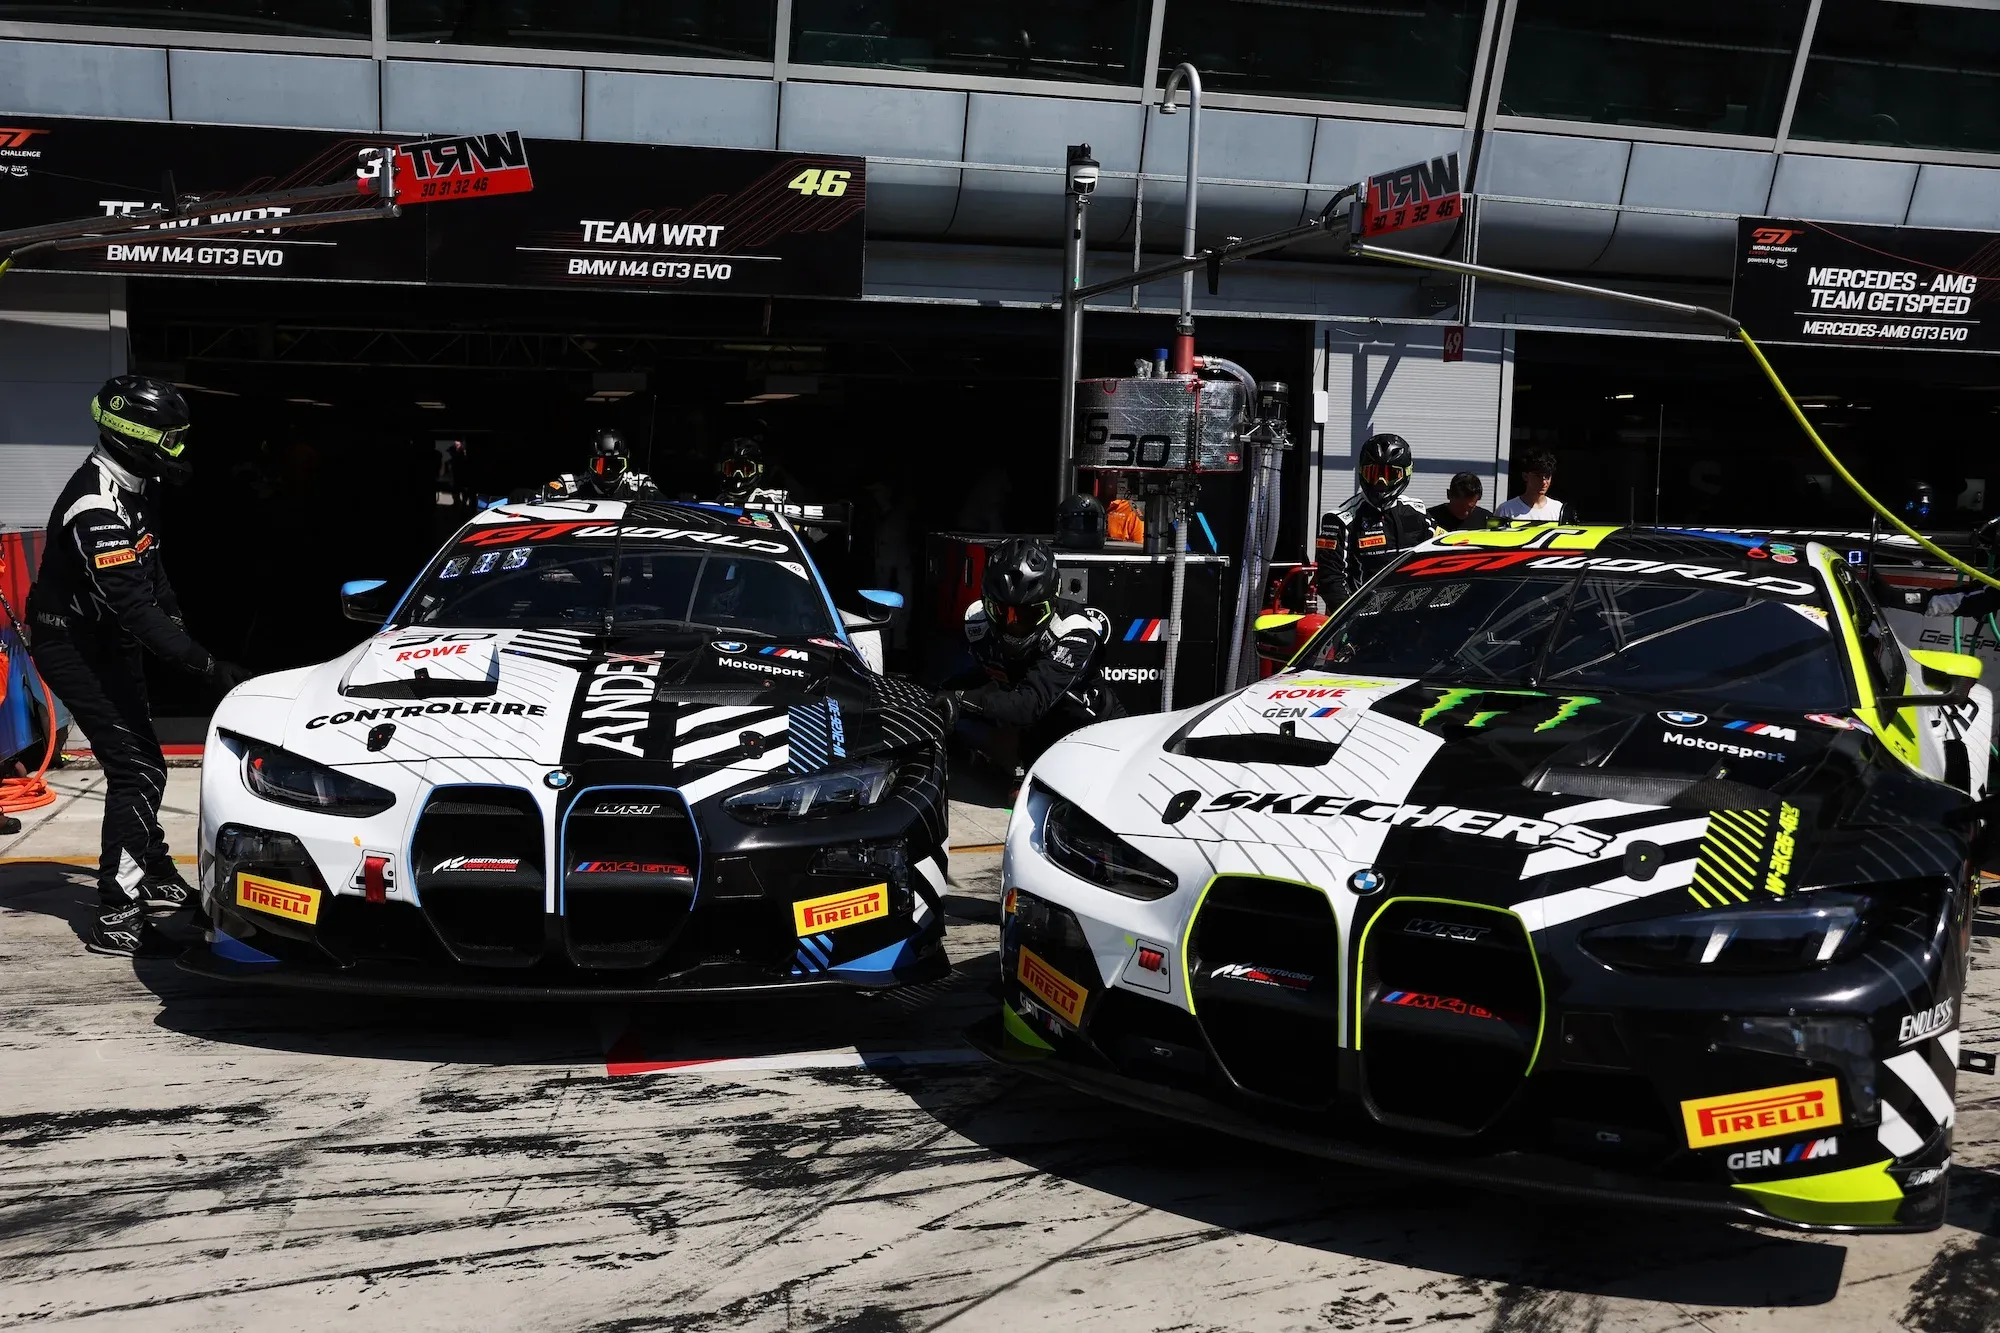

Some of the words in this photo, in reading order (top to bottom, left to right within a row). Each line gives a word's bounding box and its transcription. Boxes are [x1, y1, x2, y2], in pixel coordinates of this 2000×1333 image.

[0, 128, 51, 148] T
[0, 149, 41, 158] CHALLENGE
[421, 183, 436, 198] 30
[438, 181, 453, 196] 31
[453, 179, 470, 194] 32
[472, 177, 489, 191] 46
[787, 168, 852, 197] 46
[1393, 209, 1407, 227] 31
[1412, 204, 1430, 223] 32
[1435, 199, 1456, 217] 46
[579, 219, 657, 245] TEAM
[662, 223, 725, 248] WRT
[1752, 227, 1804, 246] GT
[106, 244, 160, 263] BMW
[162, 246, 194, 264] M4
[197, 247, 239, 265] GT3
[241, 248, 284, 267] EVO
[567, 258, 617, 276] BMW
[619, 260, 649, 277] M4
[651, 261, 691, 279] GT3
[693, 264, 732, 281] EVO
[1807, 266, 1918, 292] MERCEDES
[1929, 273, 1978, 295] AMG
[1810, 288, 1867, 310] TEAM
[1866, 291, 1972, 316] GETSPEED
[1444, 331, 1463, 354] 49
[1802, 320, 1912, 340] MERCEDES-AMG
[1910, 325, 1940, 340] GT3
[1940, 327, 1969, 342] EVO
[1106, 433, 1172, 468] 30
[94, 539, 130, 549] Snap-on
[458, 520, 615, 547] GT
[571, 524, 790, 554] WORLD
[1395, 550, 1587, 577] GT
[1525, 555, 1816, 596] WORLD
[395, 644, 471, 663] ROWE
[718, 656, 805, 679] Motorsport
[1267, 688, 1351, 700] ROWE
[304, 701, 549, 731] CONTROLFIRE
[1261, 707, 1308, 718] GEN
[1662, 731, 1786, 763] Motorsport
[594, 803, 670, 815] WRT
[1200, 790, 1622, 859] SKECHERS
[641, 864, 690, 876] GT3
[243, 880, 312, 916] PIRELLI
[803, 892, 880, 928] PIRELLI
[1403, 918, 1492, 941] WRT
[1022, 955, 1079, 1015] PIRELLI
[1898, 996, 1954, 1041] ENDLESS
[1696, 1090, 1824, 1137] PIRELLI
[1726, 1146, 1781, 1170] GEN
